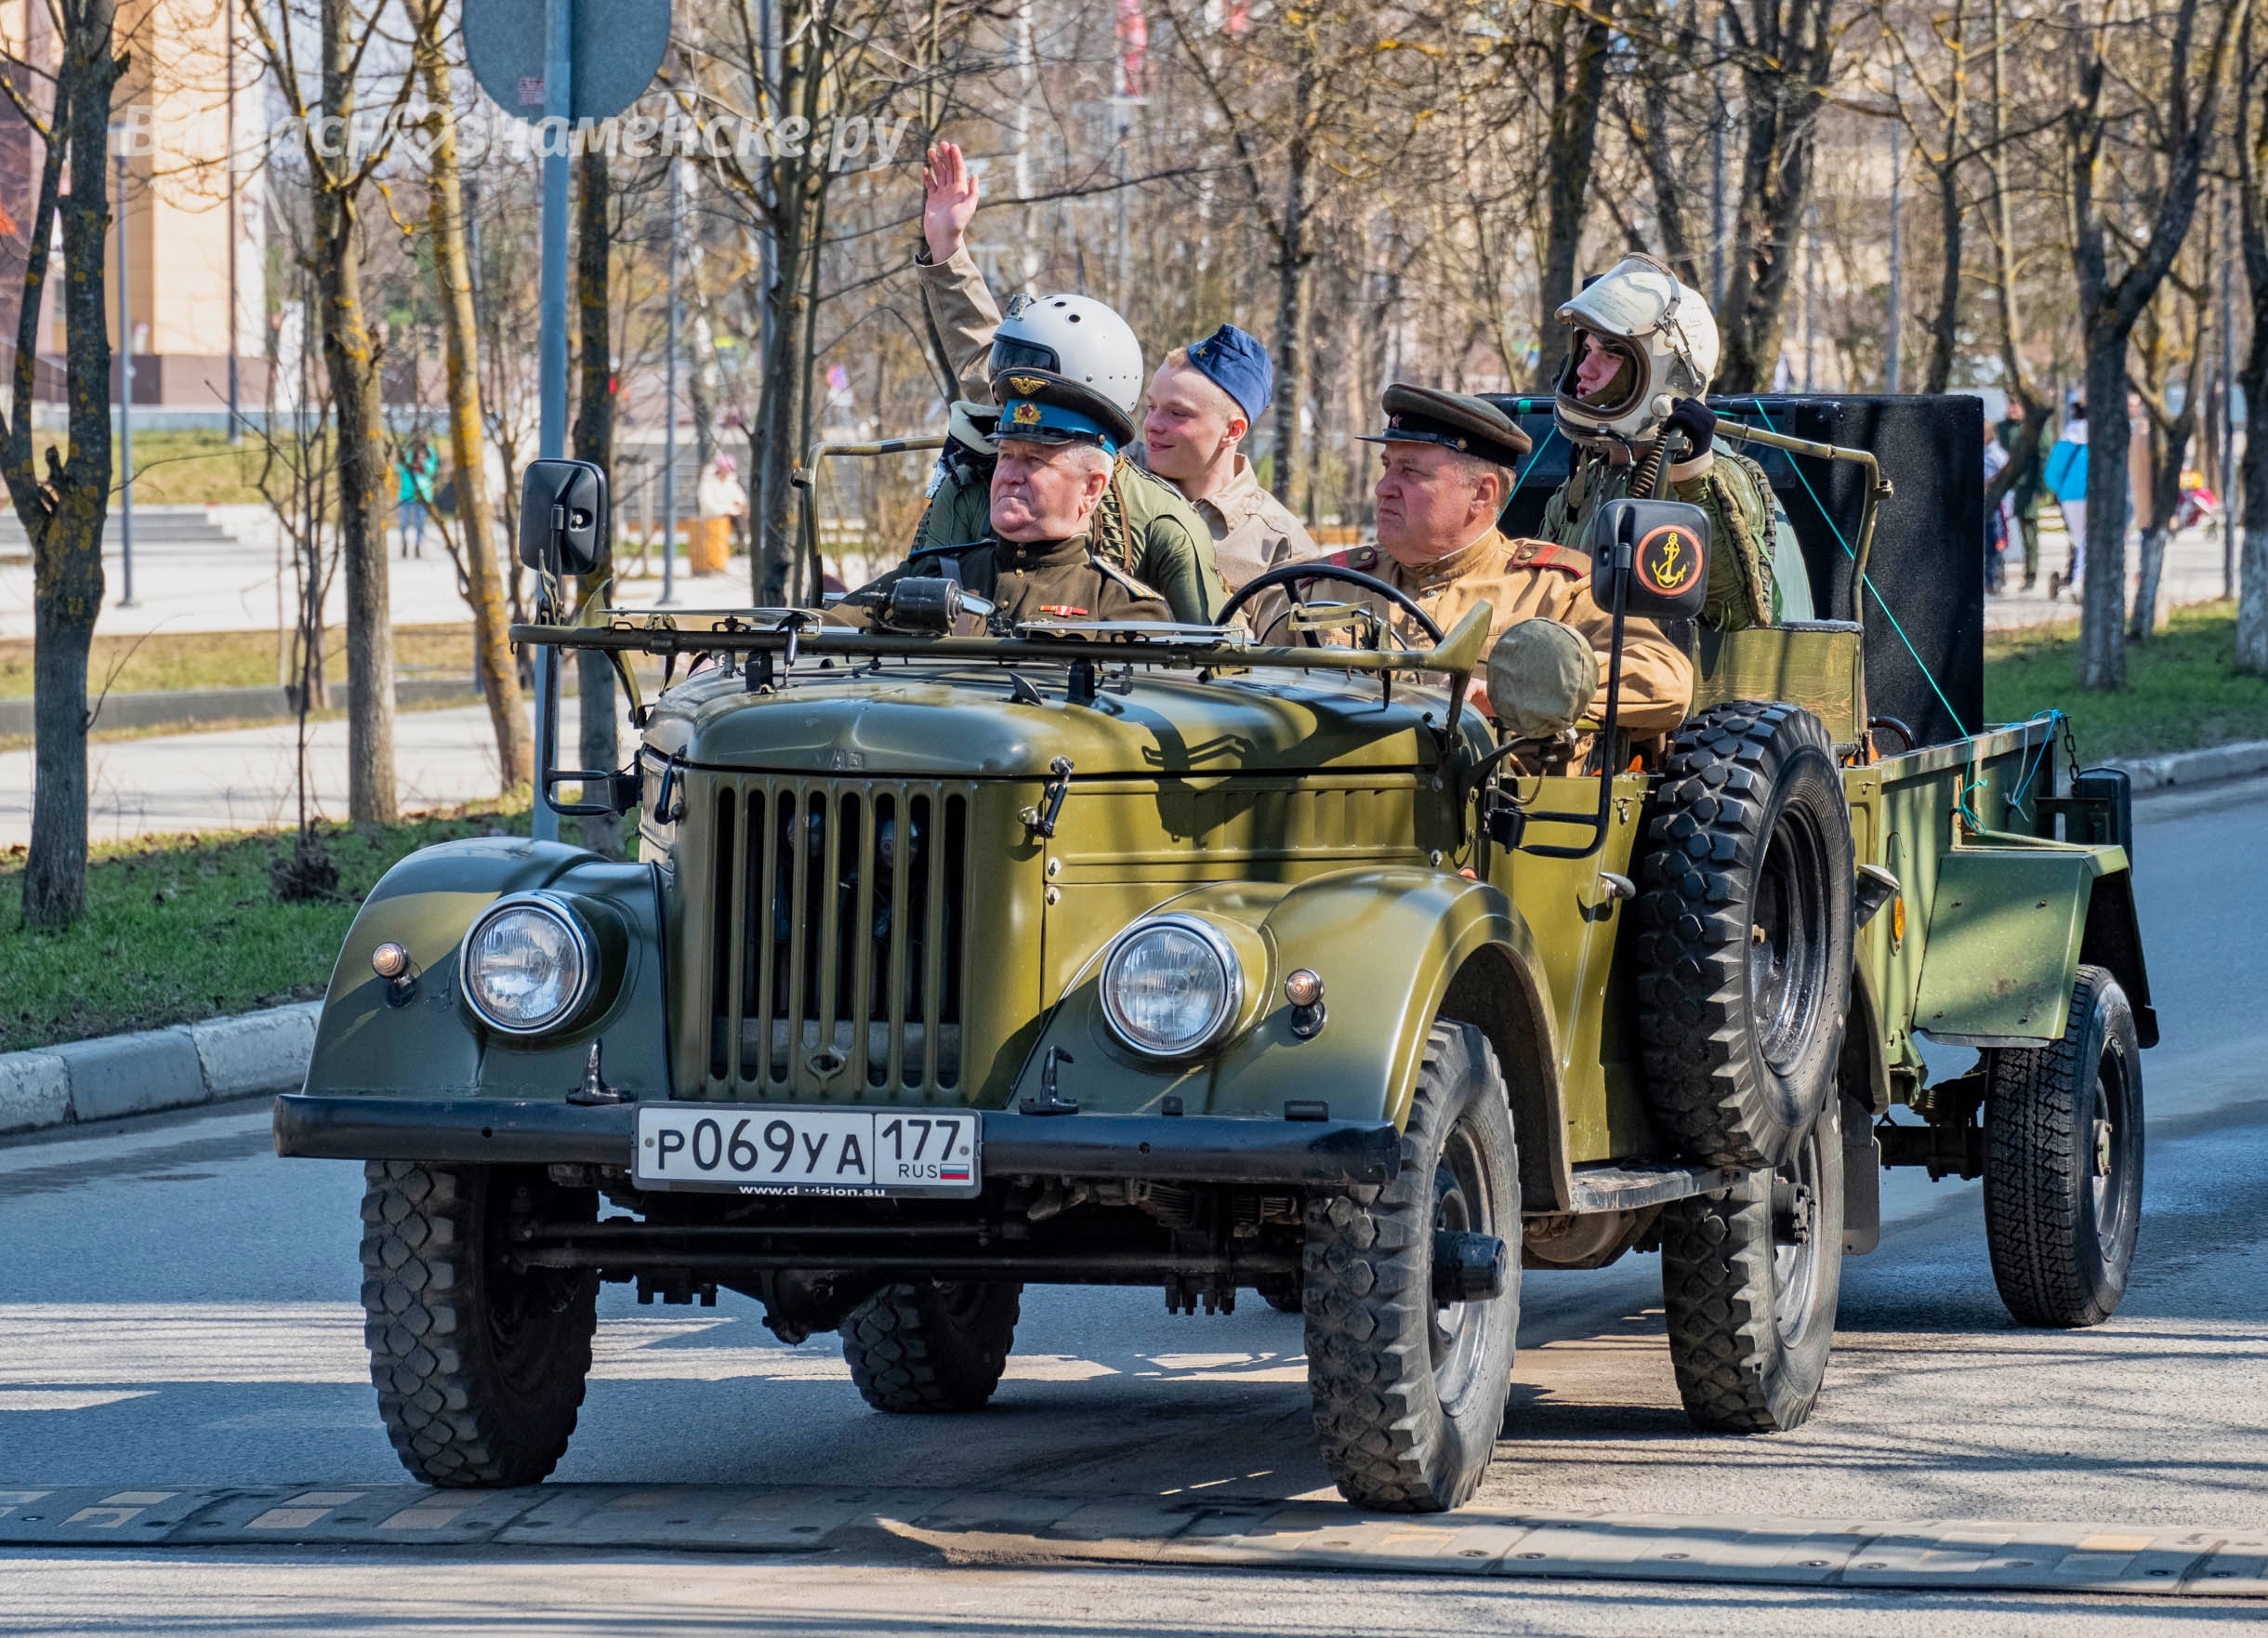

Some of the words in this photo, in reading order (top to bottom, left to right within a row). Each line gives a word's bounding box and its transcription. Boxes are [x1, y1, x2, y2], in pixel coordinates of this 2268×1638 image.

[881, 1118, 961, 1161] 177
[898, 1163, 938, 1179] RUS
[738, 1185, 886, 1197] www.dizion.su
